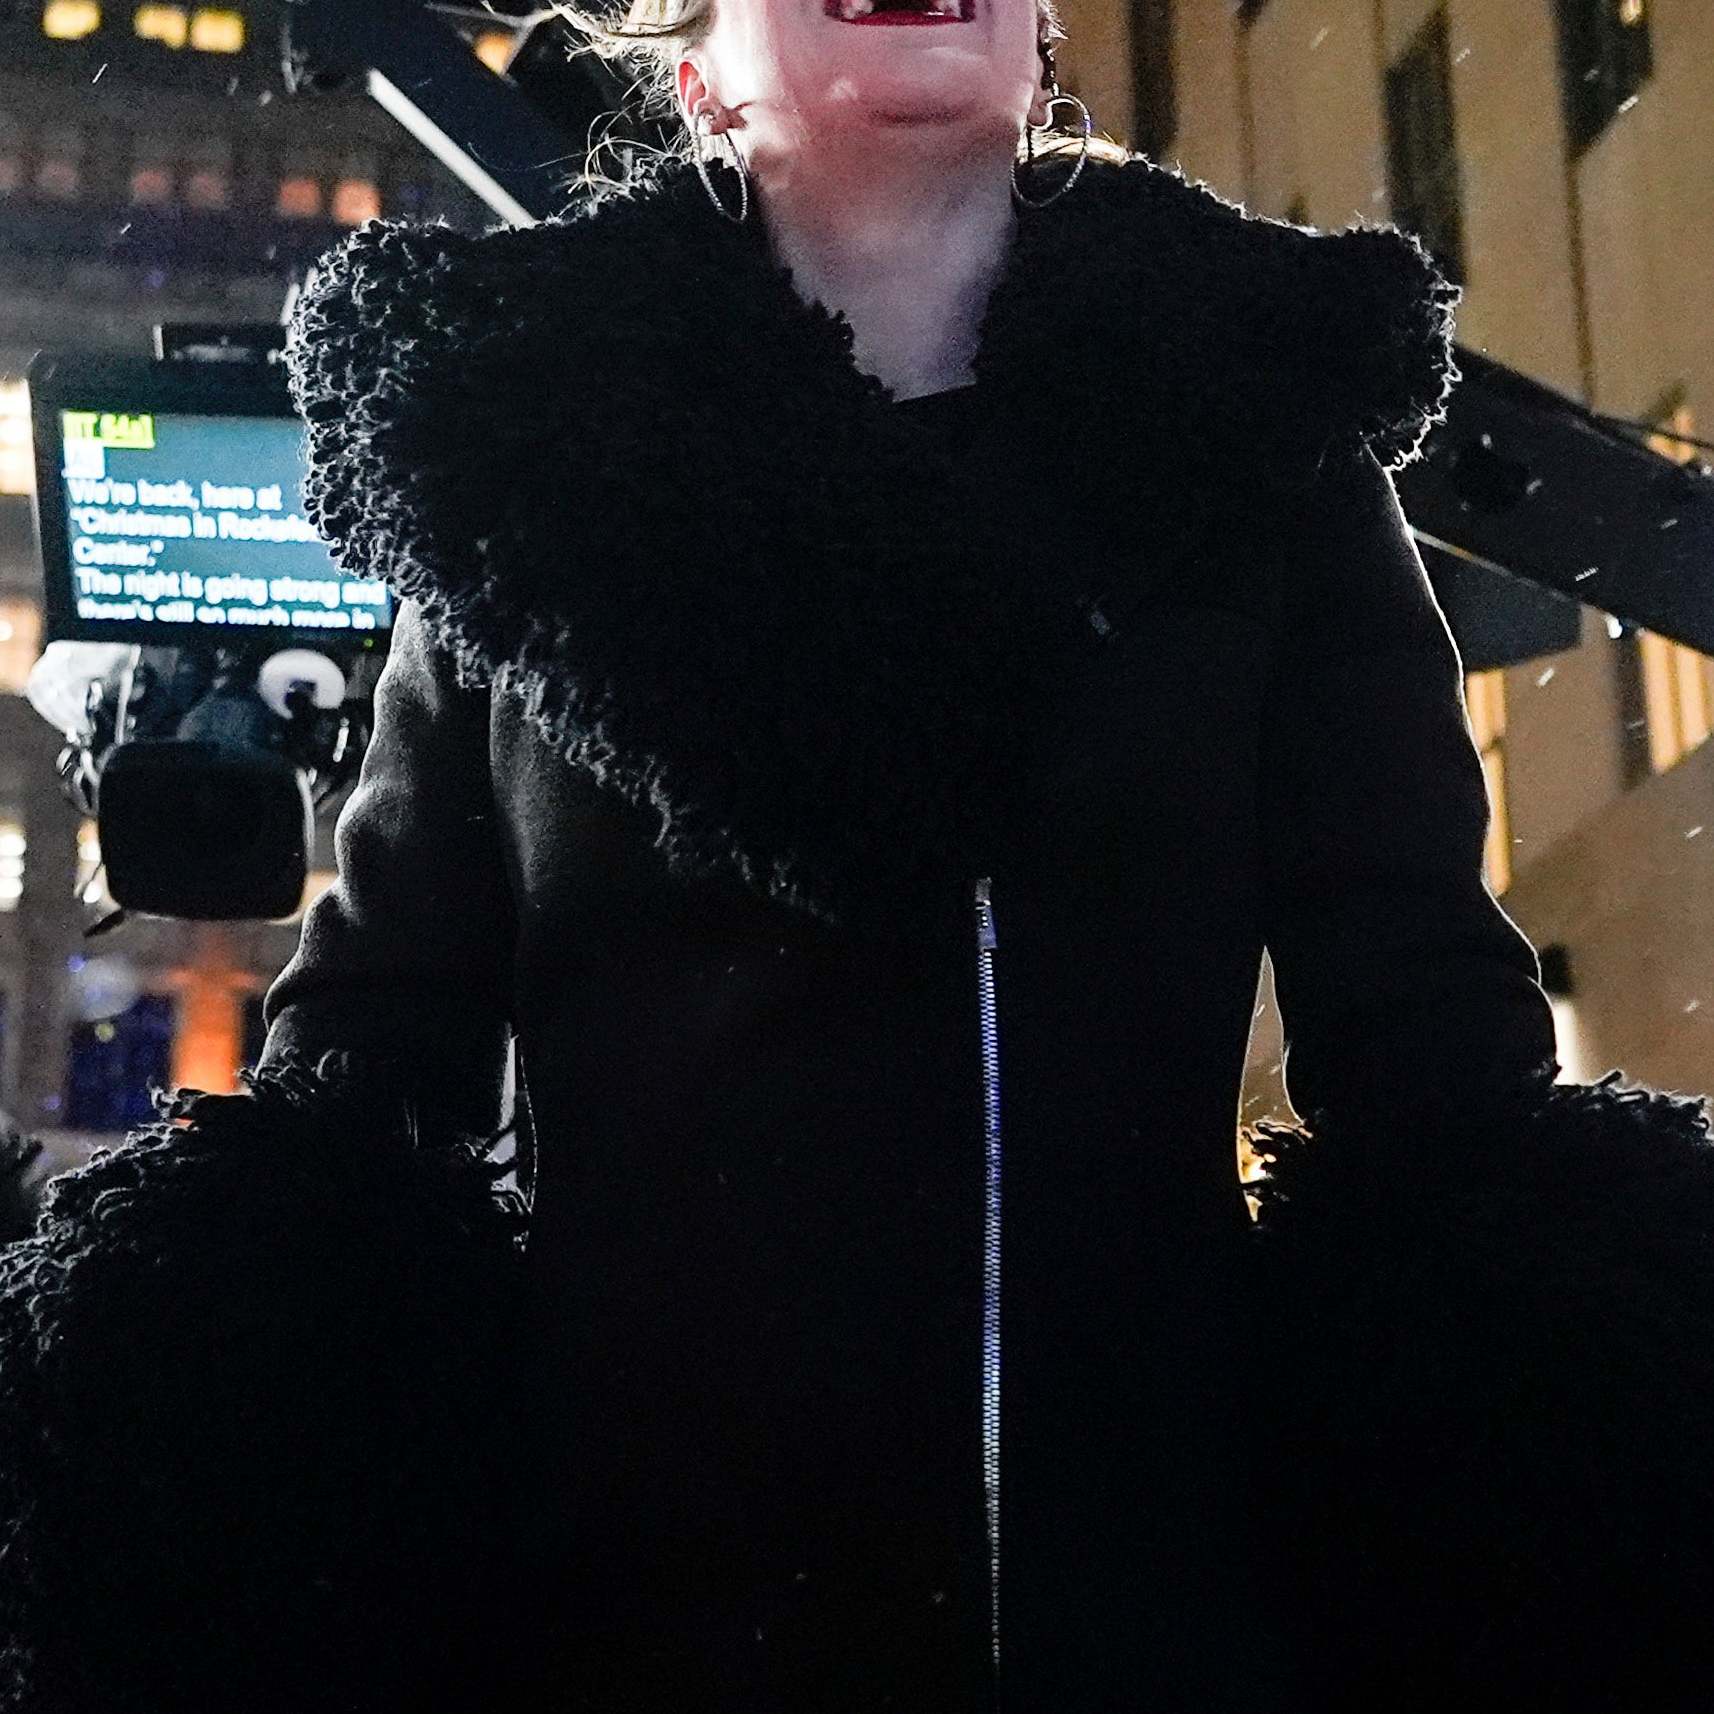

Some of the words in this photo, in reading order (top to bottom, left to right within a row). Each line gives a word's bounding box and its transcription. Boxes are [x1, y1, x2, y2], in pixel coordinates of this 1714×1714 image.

[68, 479, 136, 505] We're
[138, 480, 199, 510] back,
[202, 482, 253, 509] here
[257, 485, 282, 510] at
[194, 512, 216, 537] in
[76, 568, 121, 594] The
[125, 572, 179, 600] night
[182, 572, 202, 597] is
[205, 574, 267, 605] going
[270, 578, 339, 607] strong
[343, 581, 386, 604] and
[353, 609, 374, 628] in
